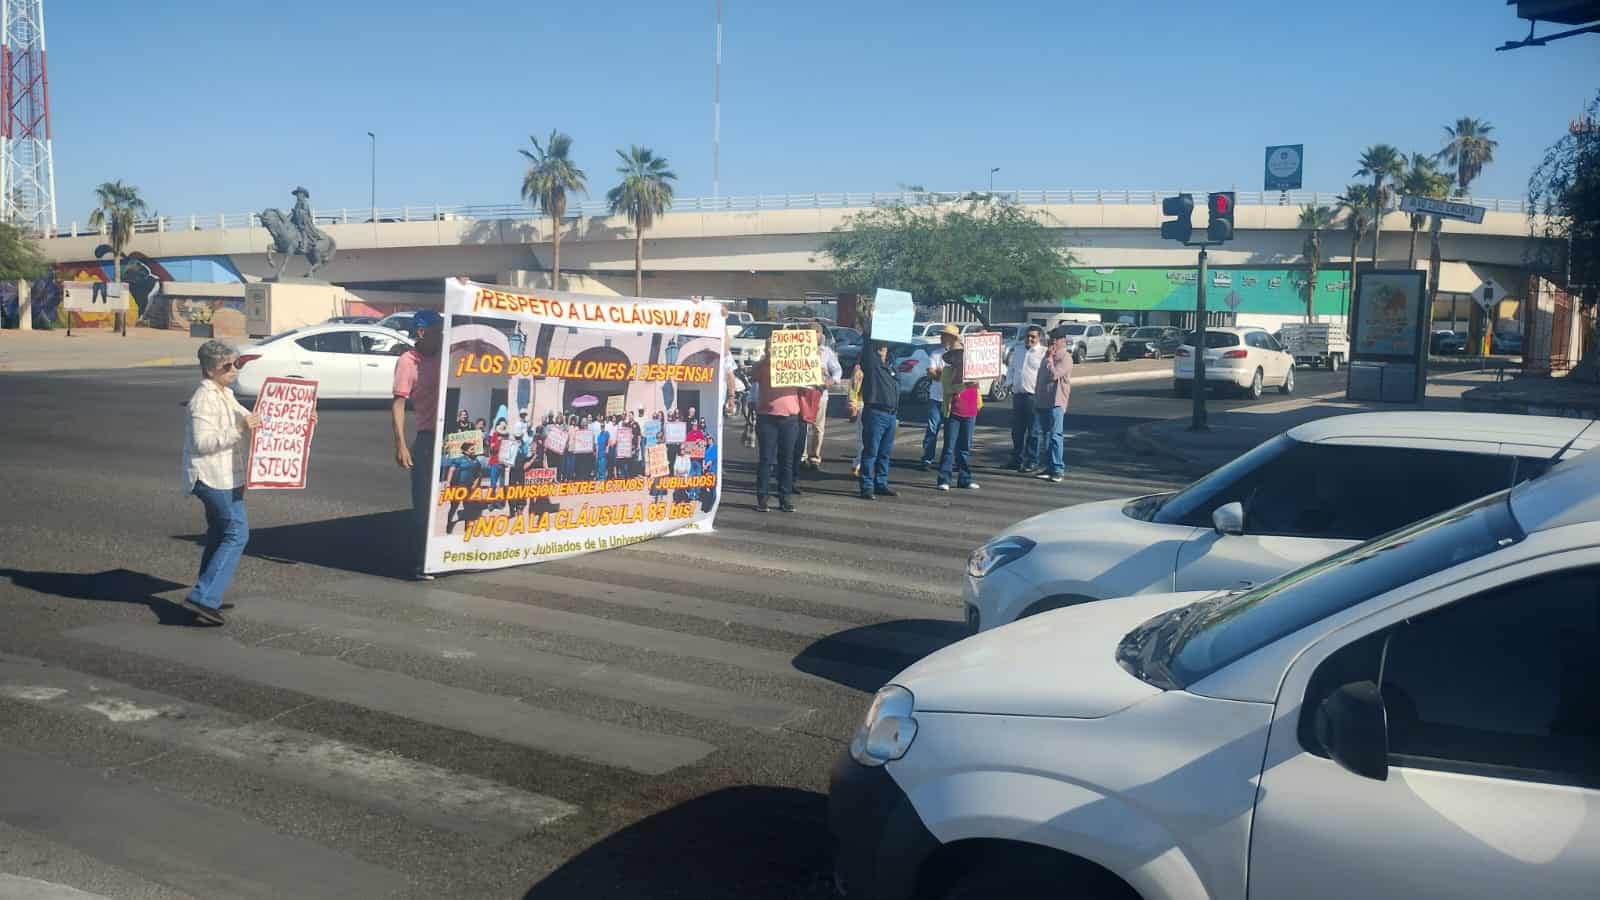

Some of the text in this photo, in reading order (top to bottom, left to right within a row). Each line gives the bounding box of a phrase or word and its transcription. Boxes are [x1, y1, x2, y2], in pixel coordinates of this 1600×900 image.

[473, 287, 564, 318] ¡RESPETO
[568, 303, 580, 320] A
[583, 303, 605, 322] LA
[609, 303, 690, 329] CLÁUSULA
[773, 331, 812, 344] EXIGIMOS
[773, 344, 811, 359] RESPETO
[456, 352, 715, 383] ¡LOS DOS MILLONES A DESPENSA!
[776, 359, 812, 371] CLAUSULA
[776, 371, 817, 384] DESPENSA
[266, 384, 315, 403] UNISON
[256, 421, 309, 437] ACUERDOS
[255, 437, 303, 454] PLATICAS
[258, 457, 300, 478] STEUS
[438, 486, 469, 506] ¡NO
[470, 486, 485, 502] A
[486, 486, 504, 501] LA
[559, 480, 597, 498] ENTRE
[597, 478, 644, 496] ACTIVOS
[645, 478, 654, 491] Y
[655, 473, 717, 490] JUBILADOS!
[464, 513, 509, 543] ¡NO
[510, 514, 526, 535] A
[527, 511, 550, 533] LA
[554, 502, 643, 530] CLÁUSULA
[647, 502, 666, 521] 85
[443, 547, 521, 562] Pensionados
[523, 549, 531, 561] y
[533, 540, 582, 556] Jubilados
[585, 537, 597, 550] de
[598, 535, 608, 549] la
